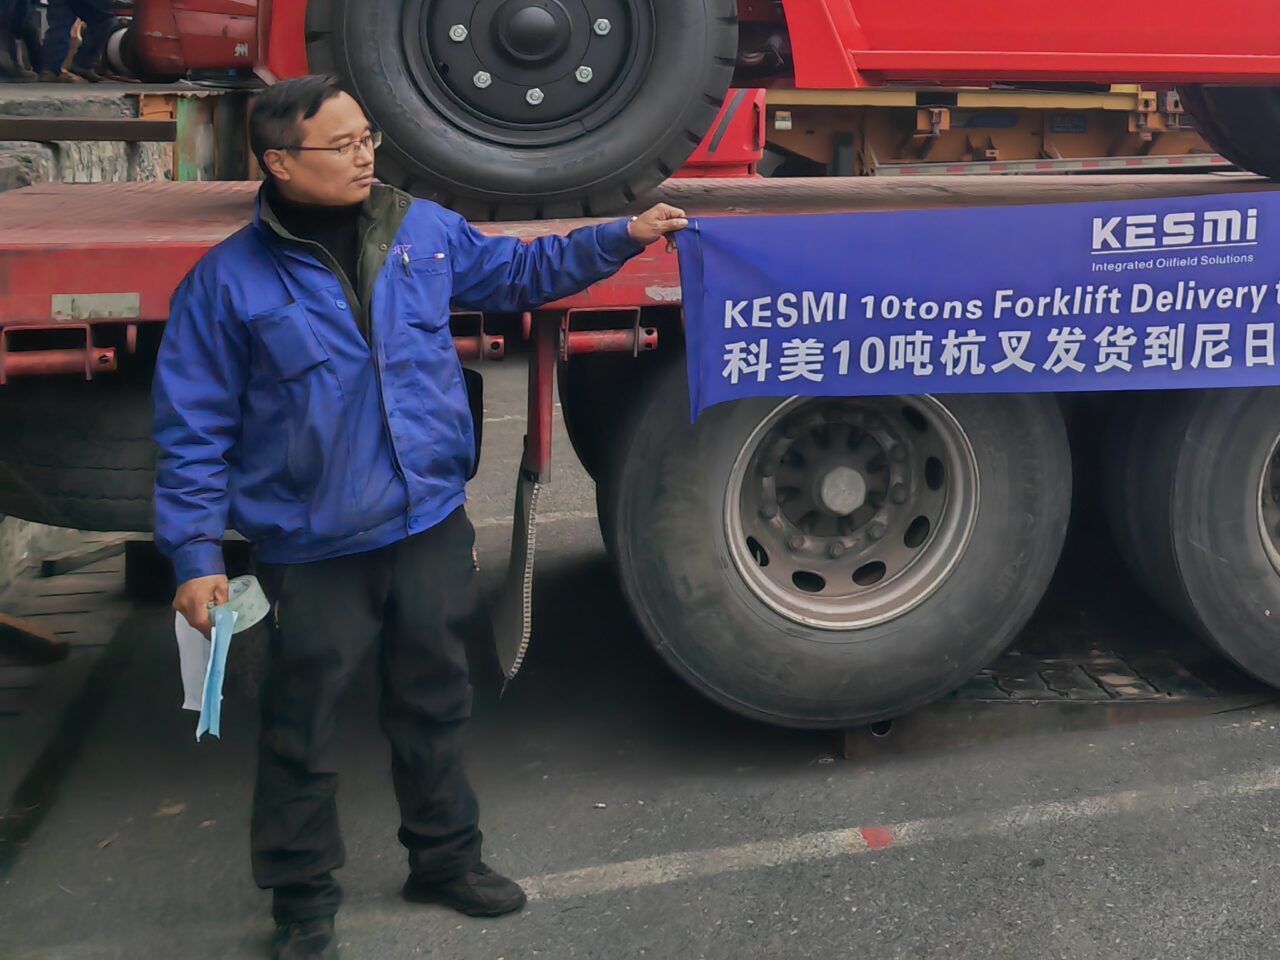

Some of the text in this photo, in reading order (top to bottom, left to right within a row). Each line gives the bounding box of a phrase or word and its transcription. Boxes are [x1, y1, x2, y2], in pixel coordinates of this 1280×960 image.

[1092, 253, 1254, 273] Integrated Oilfield Solutions
[724, 291, 847, 328] KESMI
[861, 295, 983, 320] 10tons
[993, 284, 1121, 319] Forklift
[1130, 280, 1268, 314] Delivery
